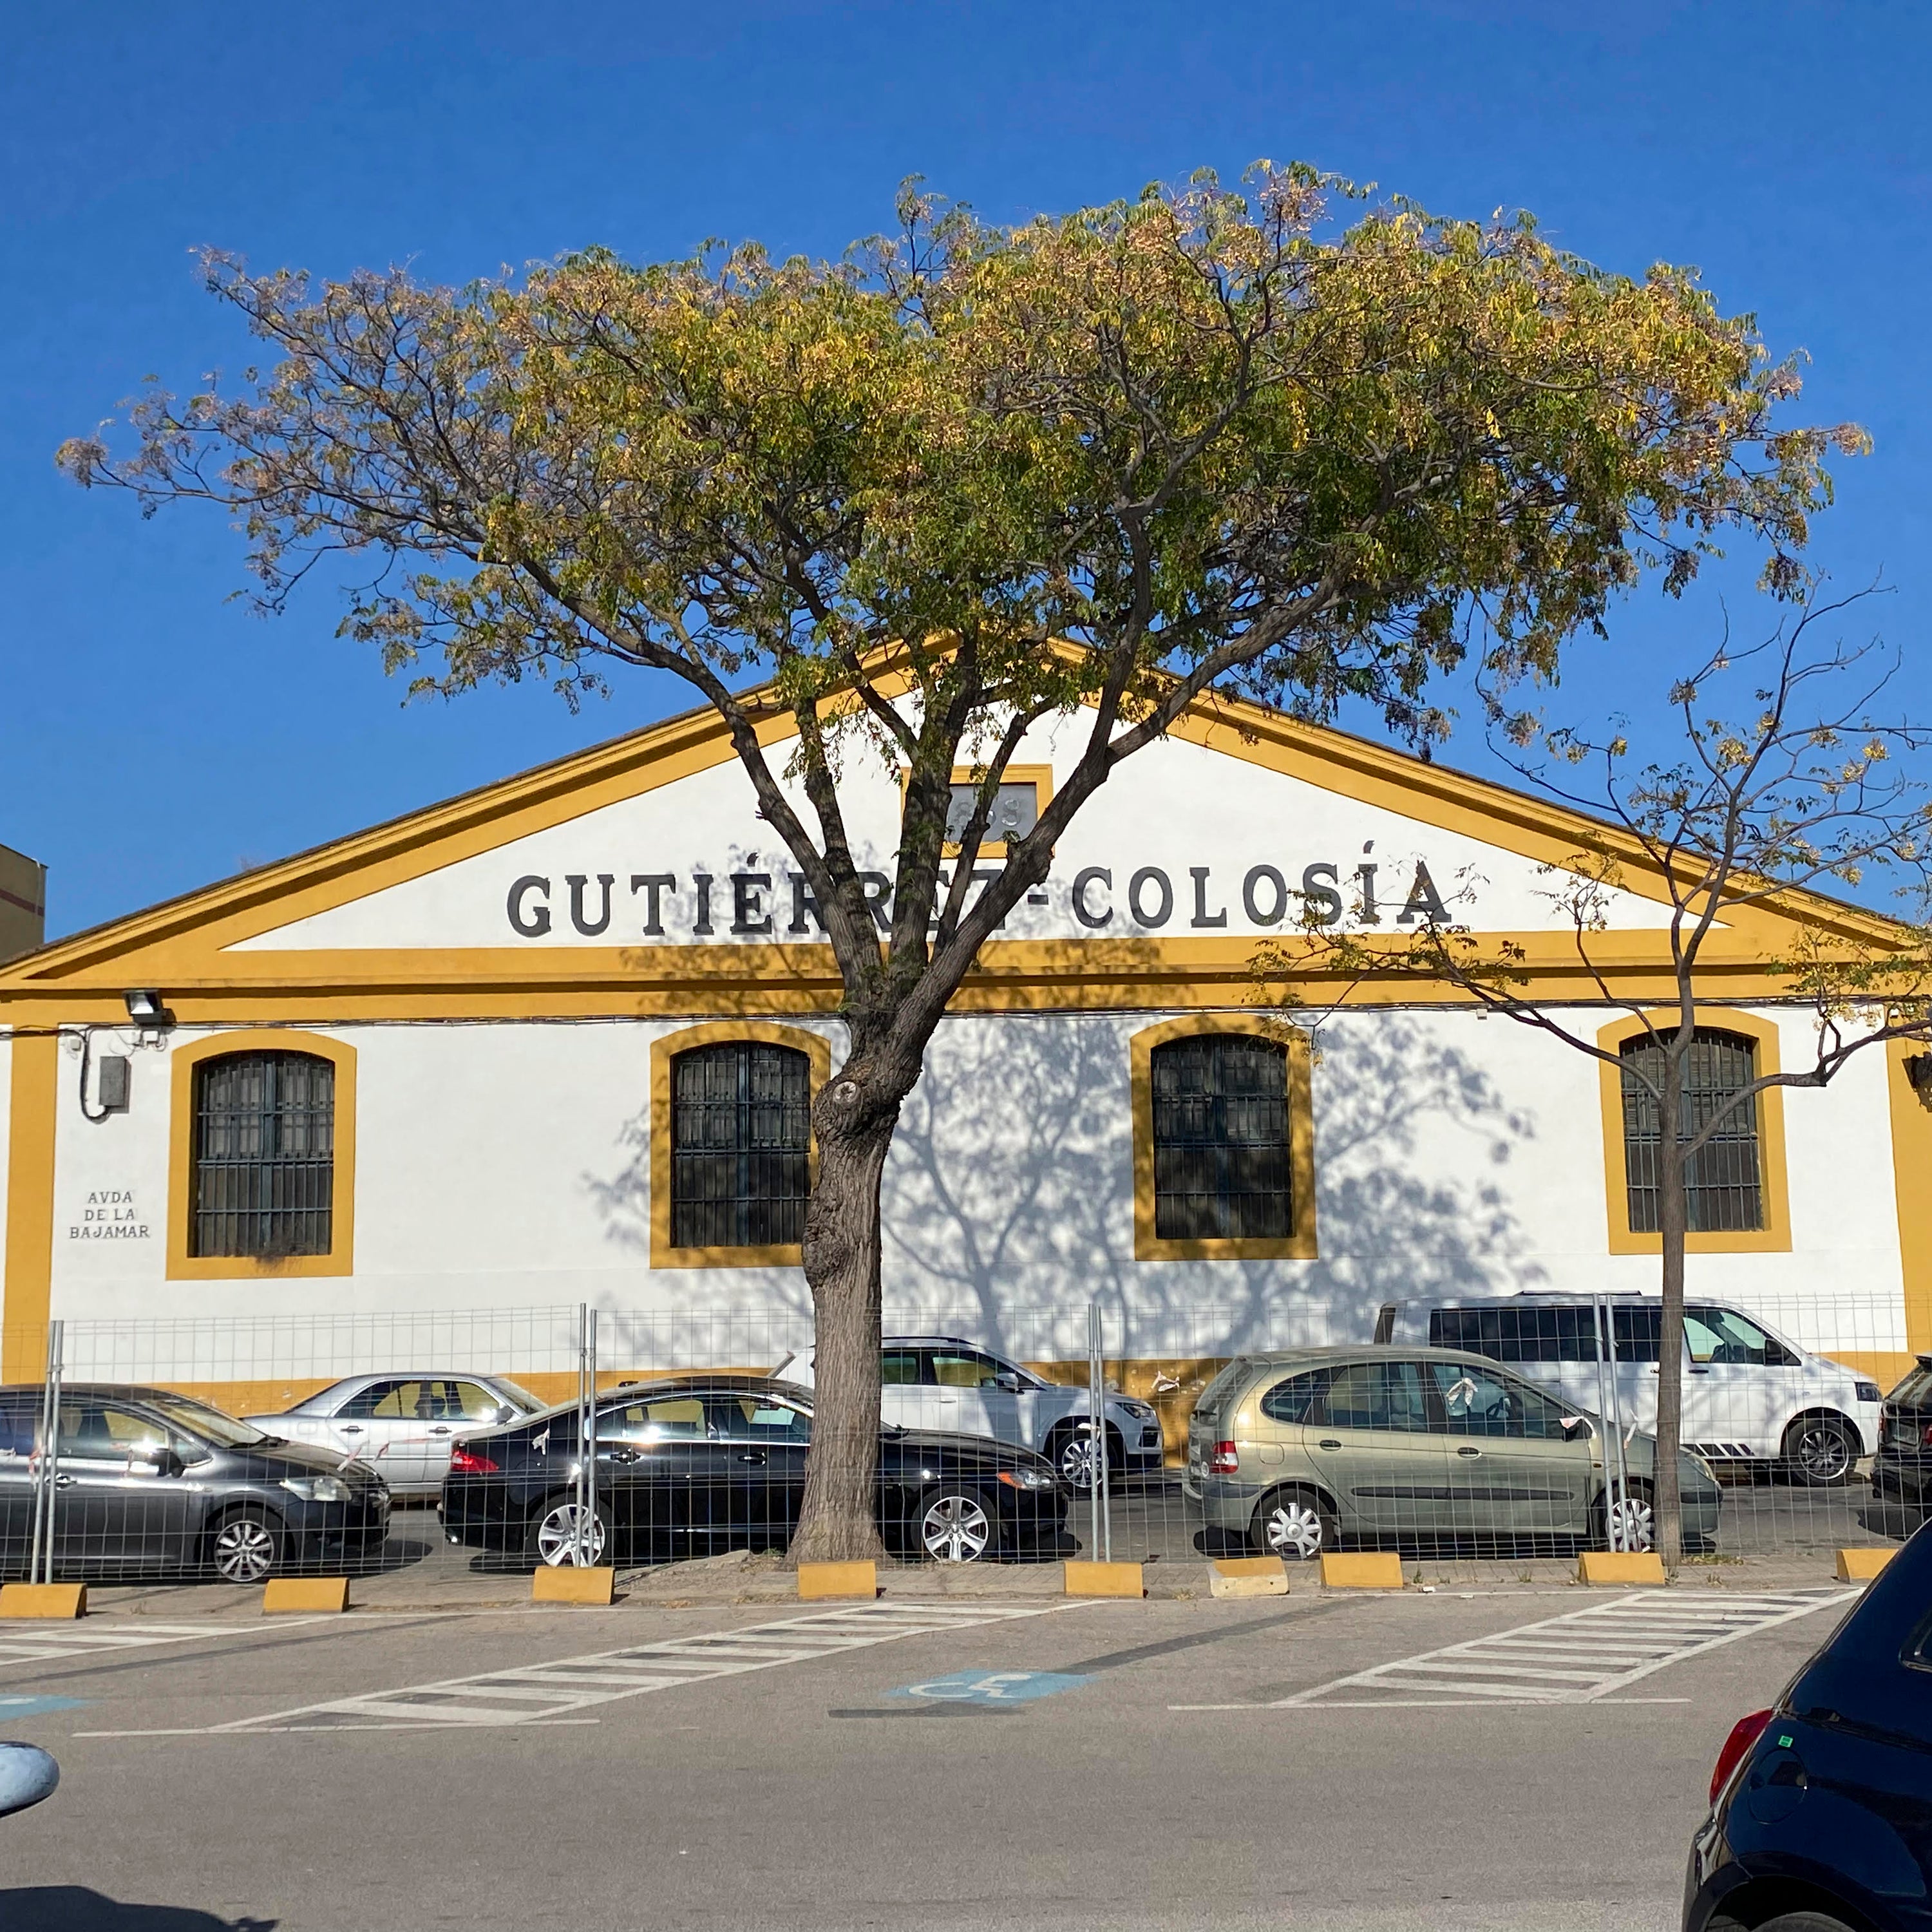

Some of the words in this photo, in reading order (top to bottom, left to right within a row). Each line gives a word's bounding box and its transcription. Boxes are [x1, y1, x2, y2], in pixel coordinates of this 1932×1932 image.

[88, 1191, 132, 1204] AVDA
[84, 1209, 105, 1221] DE
[114, 1209, 135, 1220] LA
[69, 1225, 150, 1239] BAJAMAR
